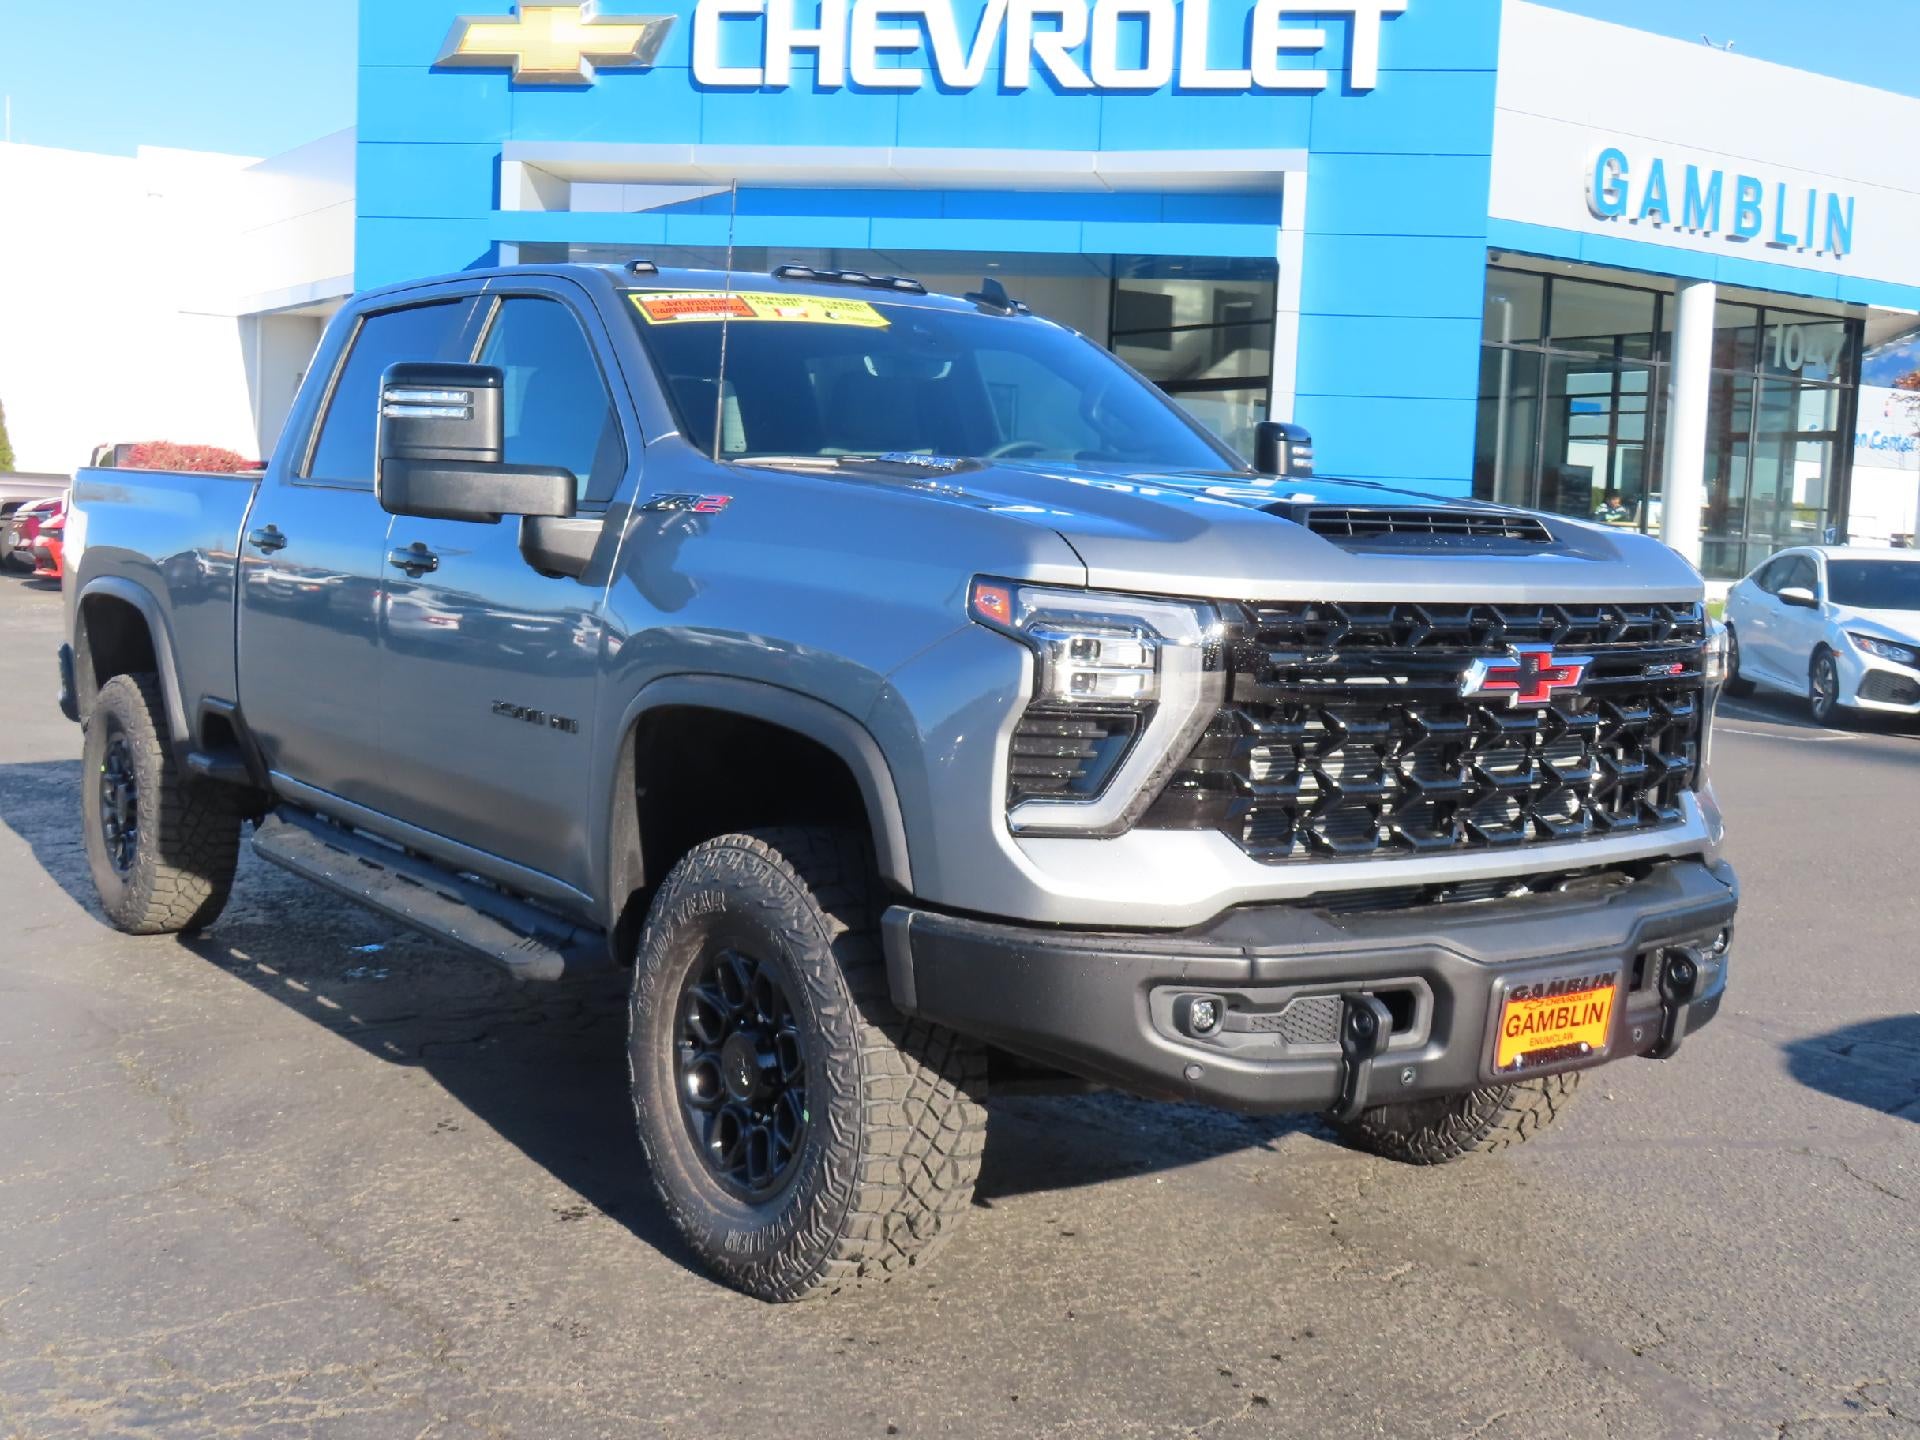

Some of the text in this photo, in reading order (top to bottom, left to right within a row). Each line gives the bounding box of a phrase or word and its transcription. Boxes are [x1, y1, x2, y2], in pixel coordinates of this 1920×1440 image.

[692, 0, 1406, 90] CHEVROLET
[1592, 147, 1855, 256] GAMBLIN
[1545, 992, 1594, 1007] CHEVROLET
[1505, 1001, 1605, 1038] GAMBLIN
[1529, 1032, 1574, 1047] ENUMCLAW
